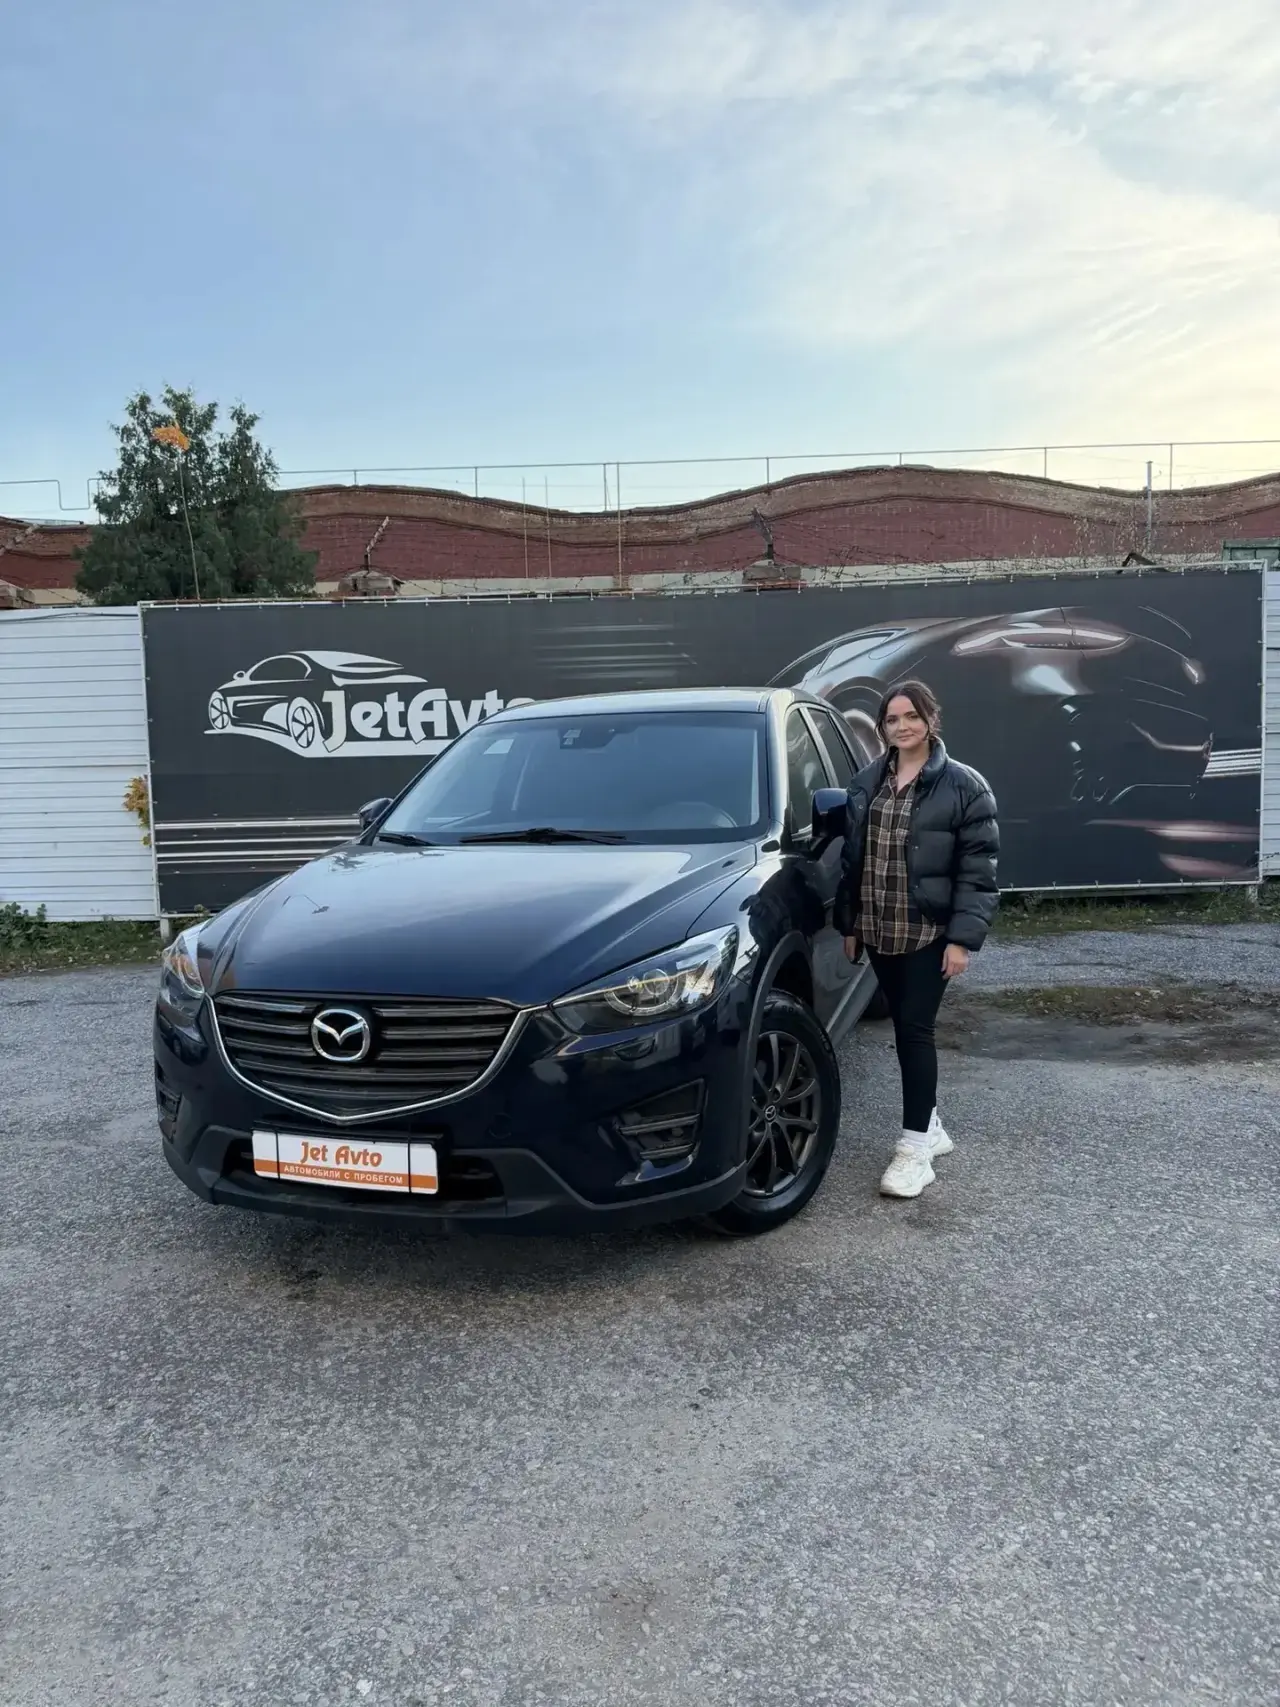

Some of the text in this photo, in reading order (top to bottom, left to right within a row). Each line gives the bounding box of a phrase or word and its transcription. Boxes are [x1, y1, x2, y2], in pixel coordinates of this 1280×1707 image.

[322, 688, 536, 752] JetAvt
[300, 1141, 382, 1167] Jet Avto
[284, 1165, 403, 1184] АВТОМОБИЛИ С ПРОБЕГОМ
